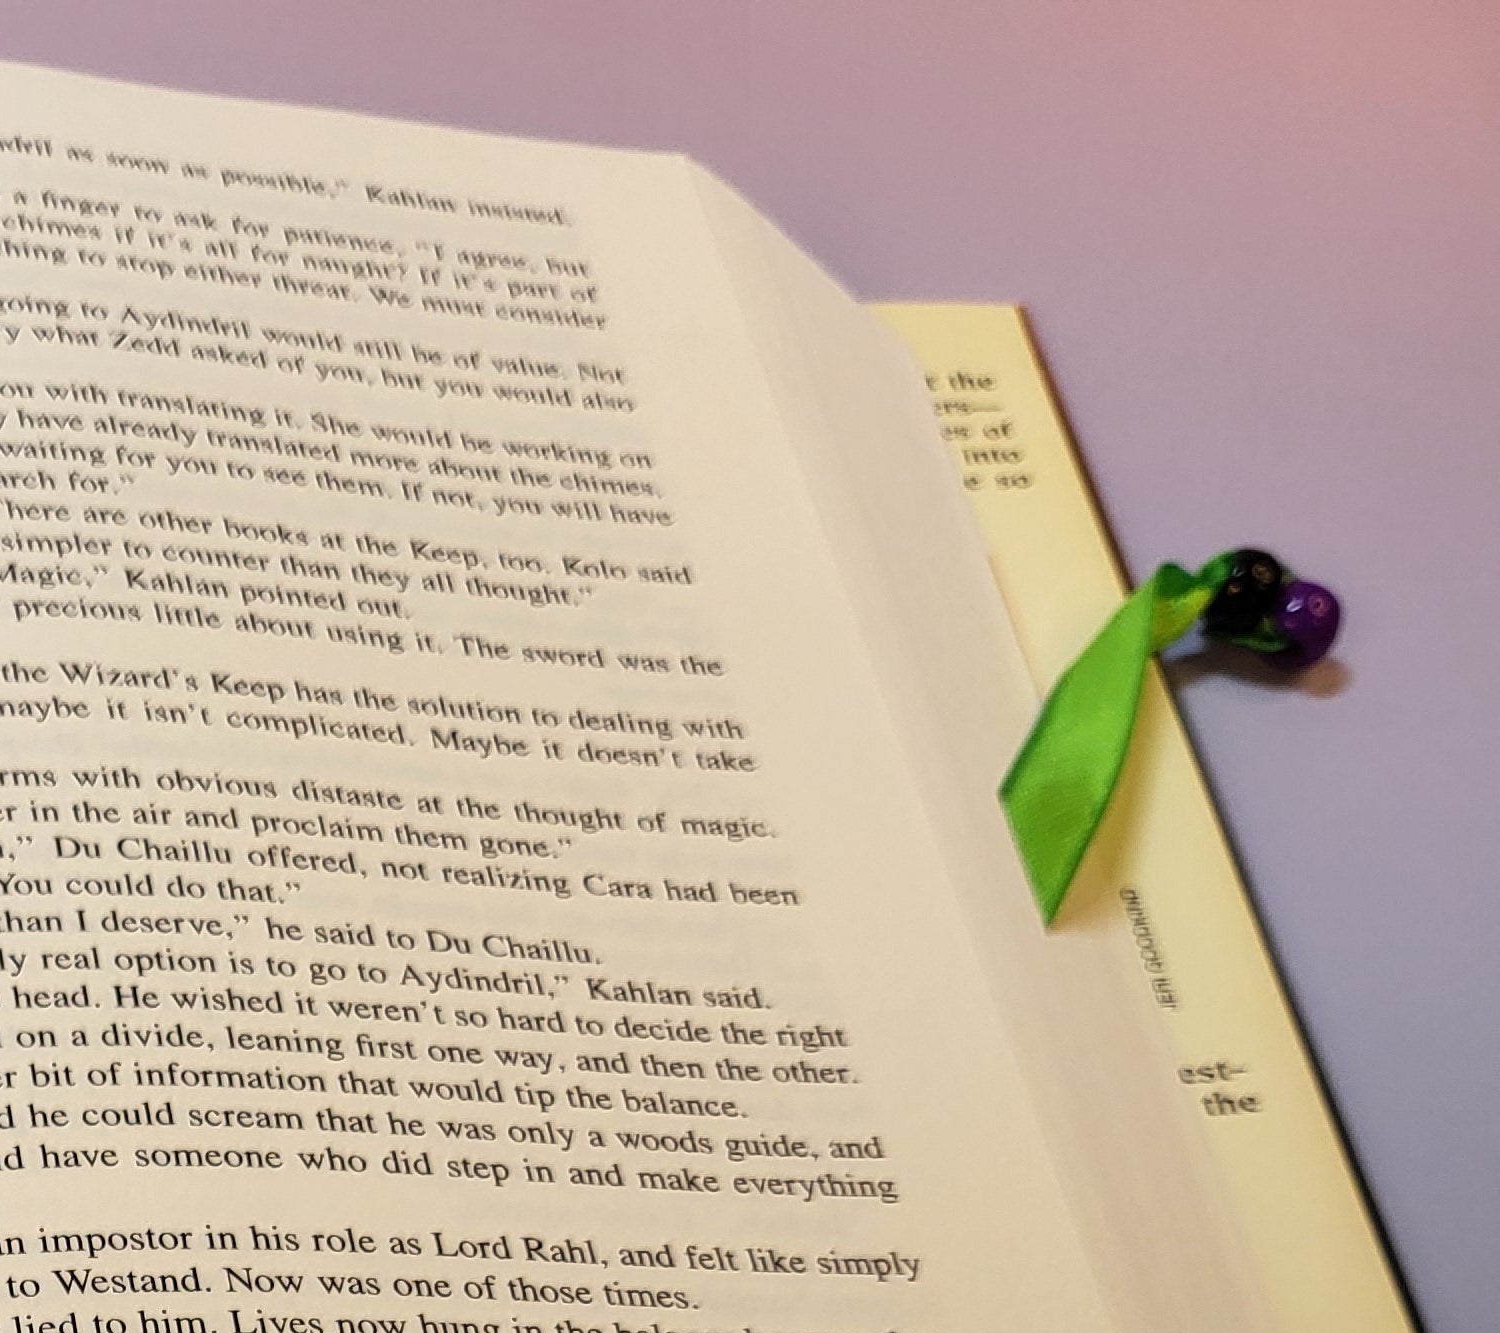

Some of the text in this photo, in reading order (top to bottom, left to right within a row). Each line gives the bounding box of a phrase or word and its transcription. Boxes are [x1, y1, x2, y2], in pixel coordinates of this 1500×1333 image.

[80, 302, 109, 321] to
[122, 305, 250, 340] Aydindril
[262, 329, 343, 353] would
[354, 339, 402, 361] still
[412, 344, 443, 365] be
[453, 351, 481, 370] of
[76, 910, 86, 932] I
[265, 917, 303, 940] he
[314, 924, 375, 946] said
[386, 930, 415, 950] to
[426, 930, 471, 954] Du
[482, 935, 600, 964] Chaillu.
[1201, 1091, 1263, 1117] the
[38, 1228, 192, 1258] impostor
[206, 1225, 238, 1250] in
[249, 1225, 300, 1251] his
[312, 1228, 376, 1253] role
[389, 1237, 422, 1255] as
[431, 1232, 513, 1259] Lord
[521, 1237, 608, 1268] Rahl,
[619, 1244, 676, 1268] and
[685, 1246, 740, 1271] felt
[746, 1248, 806, 1273] like
[817, 1252, 920, 1282] simply
